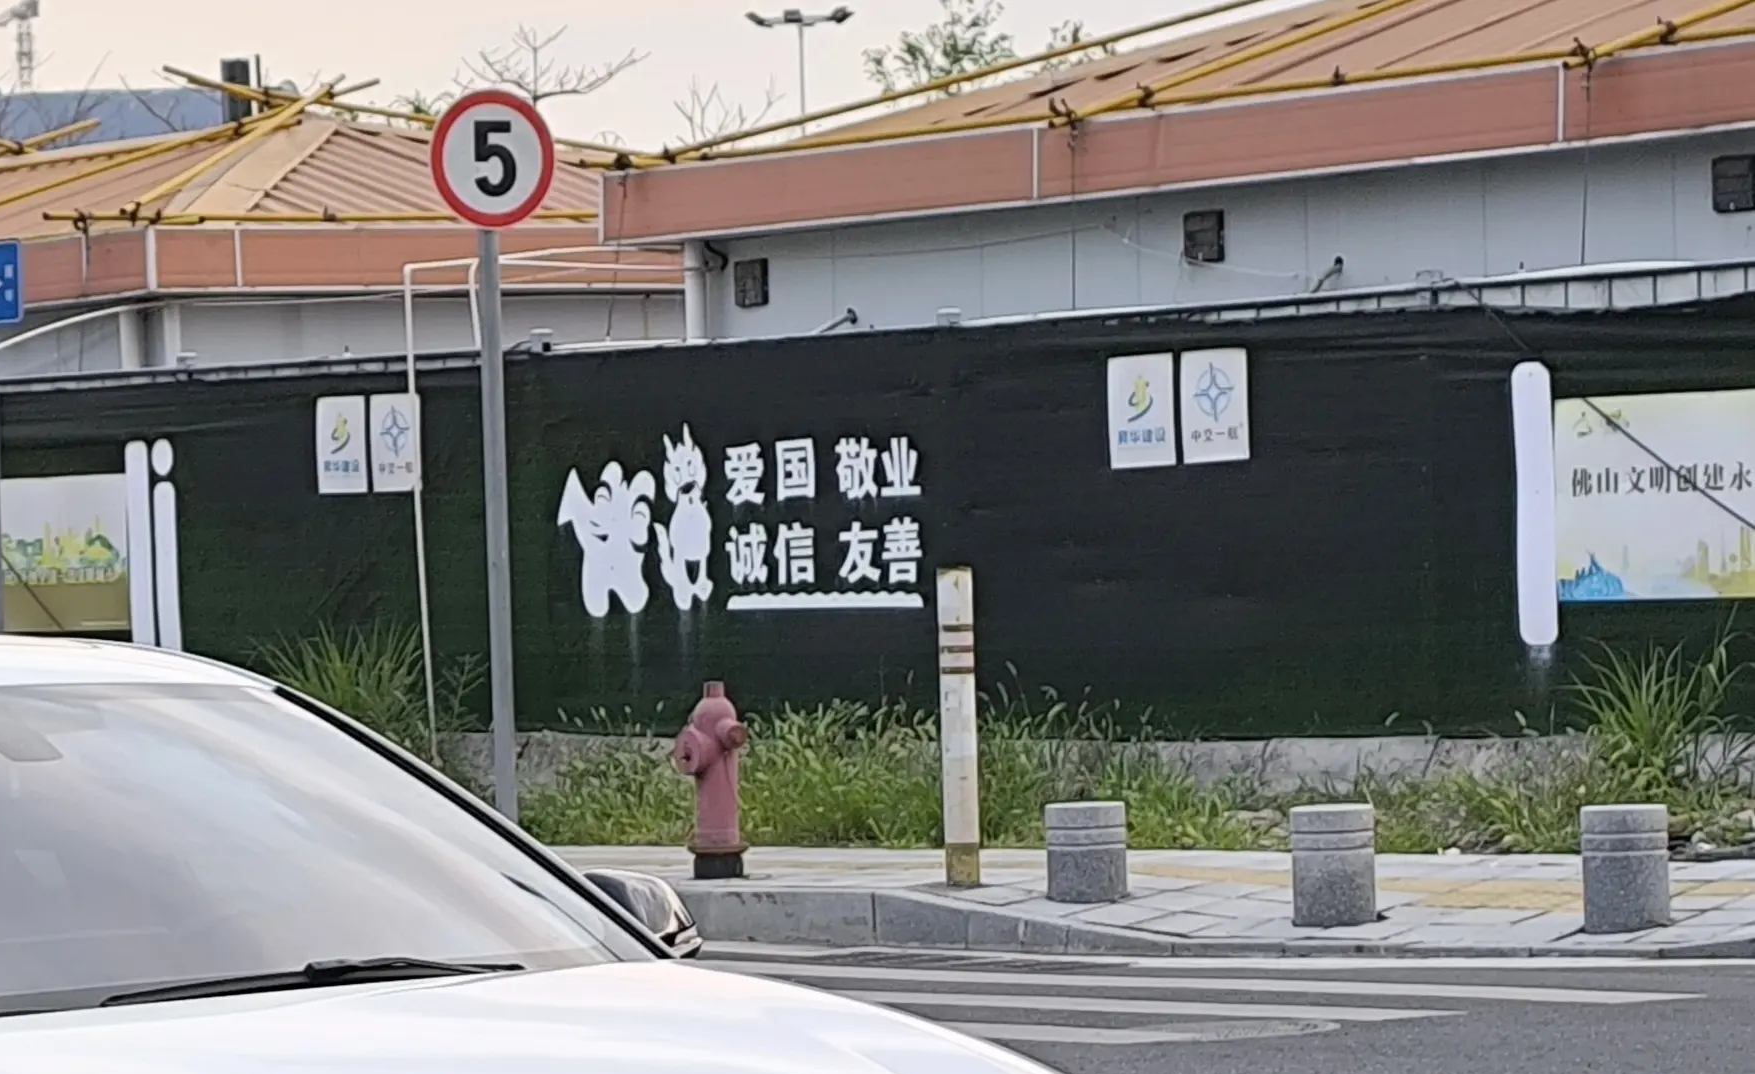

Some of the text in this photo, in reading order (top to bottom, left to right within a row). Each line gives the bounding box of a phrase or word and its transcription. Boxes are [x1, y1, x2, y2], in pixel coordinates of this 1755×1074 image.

[474, 120, 517, 197] 5
[724, 436, 922, 506] 爱国 敬业
[1572, 462, 1752, 497] 佛山文明创建永
[724, 516, 923, 585] 诚信 友善
